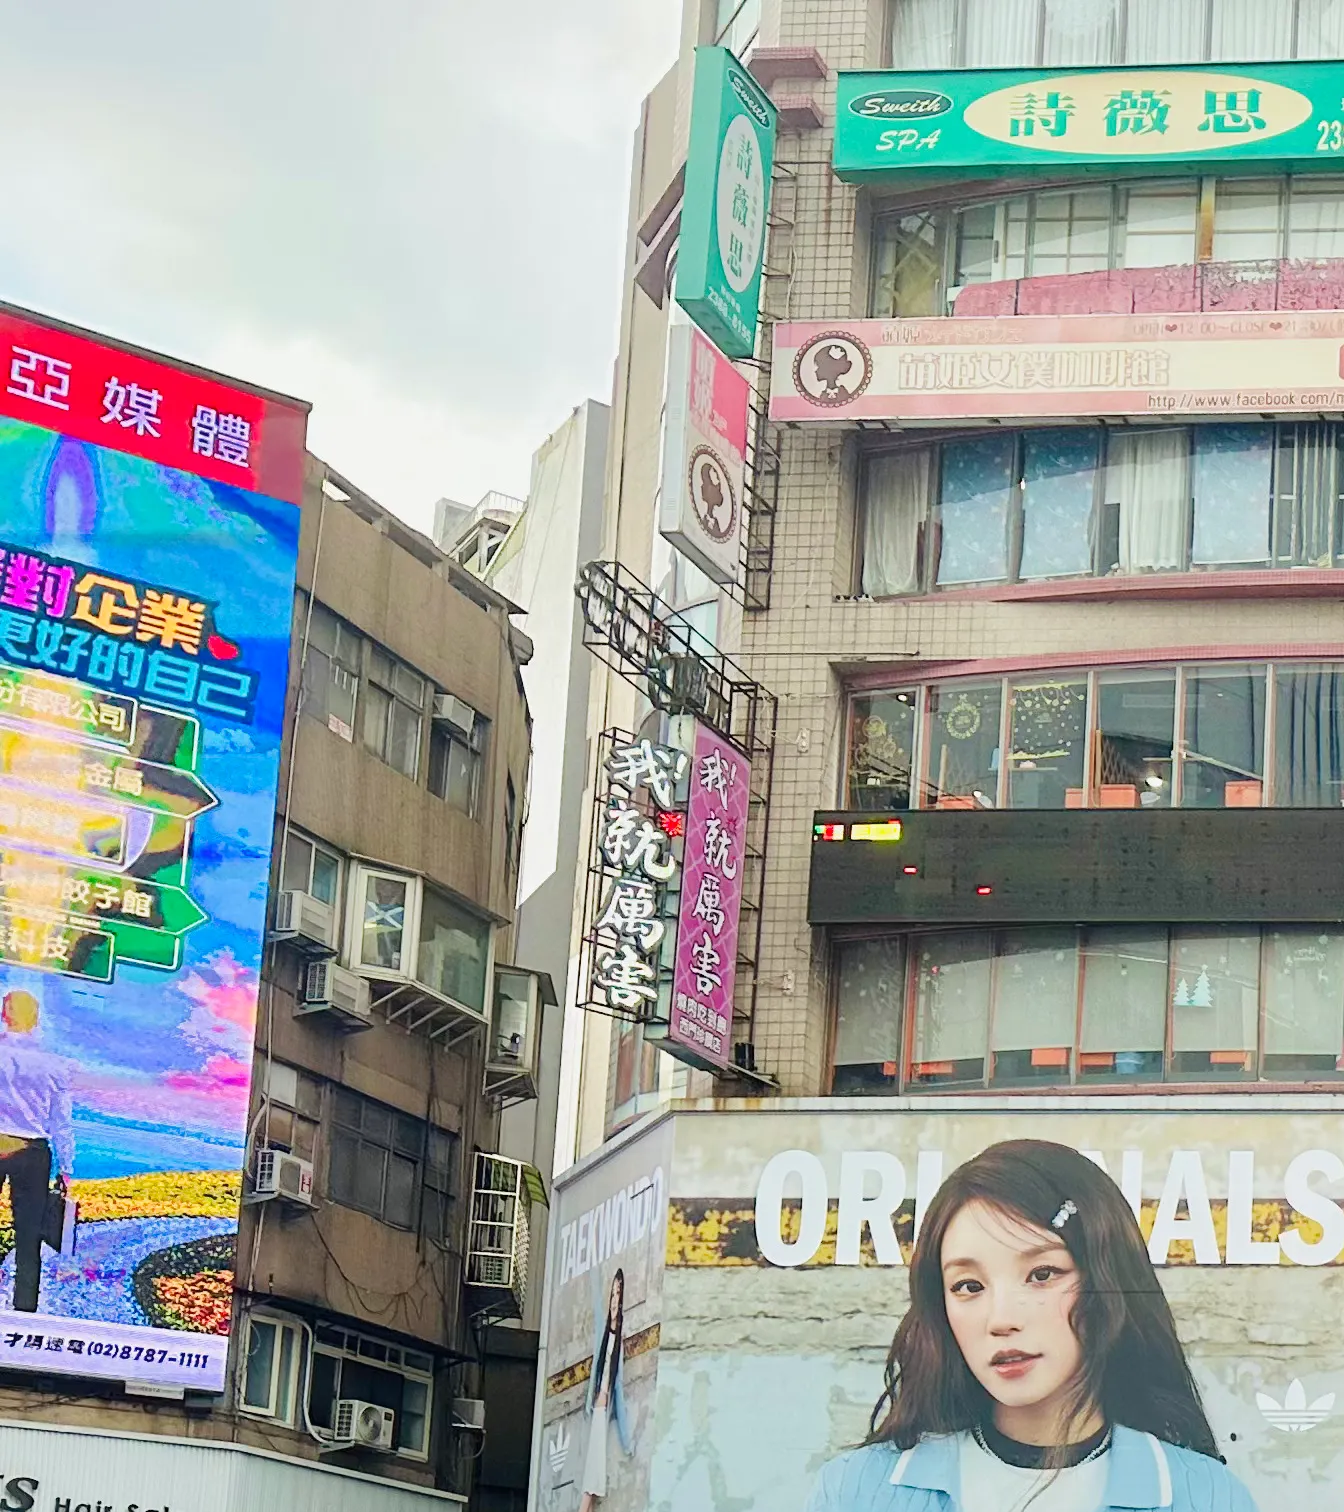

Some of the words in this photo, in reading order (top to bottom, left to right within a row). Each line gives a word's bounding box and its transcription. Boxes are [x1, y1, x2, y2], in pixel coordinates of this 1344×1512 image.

[858, 94, 942, 117] Sweith
[875, 128, 940, 153] SPA
[1008, 86, 1269, 139] 詩薇思
[726, 132, 755, 279] 詩薇思
[6, 345, 252, 468] 亞媒體
[0, 548, 205, 655] 對企業
